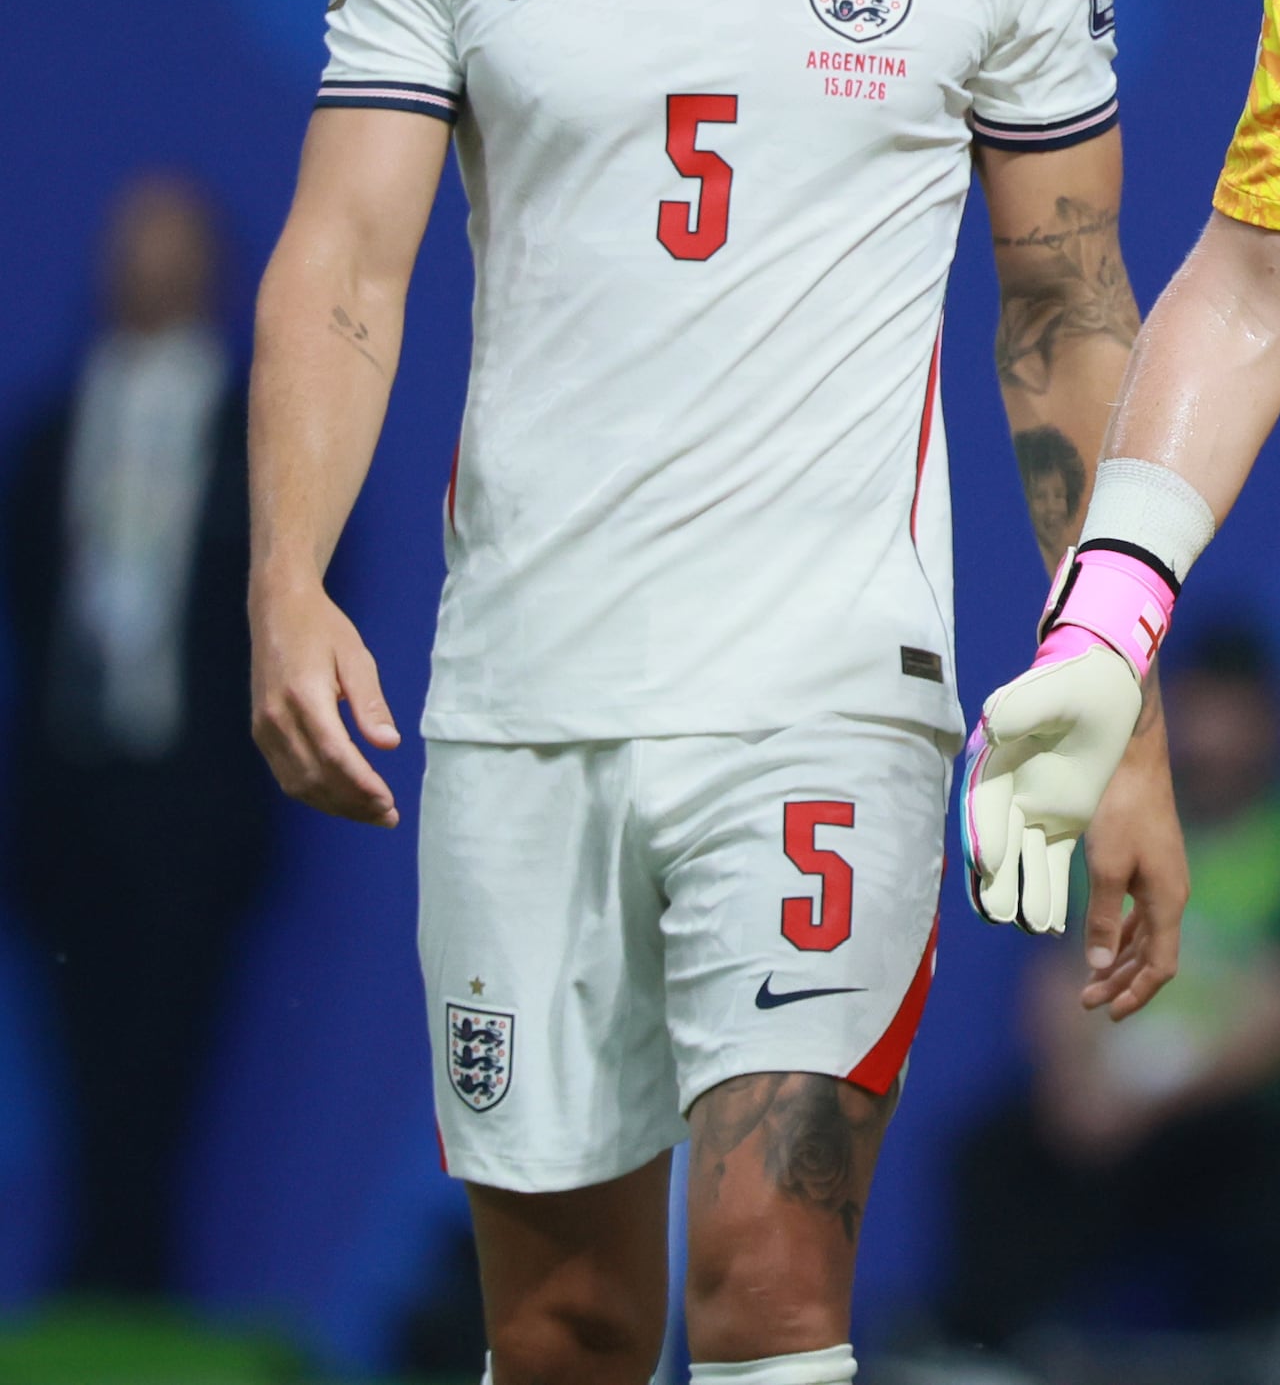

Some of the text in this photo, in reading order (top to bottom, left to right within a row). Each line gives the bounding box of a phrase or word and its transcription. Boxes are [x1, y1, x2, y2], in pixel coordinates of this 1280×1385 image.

[806, 50, 907, 78] ARGENTINA
[824, 76, 887, 101] 15.07.26
[656, 93, 738, 262] 5
[780, 800, 856, 953] 5
